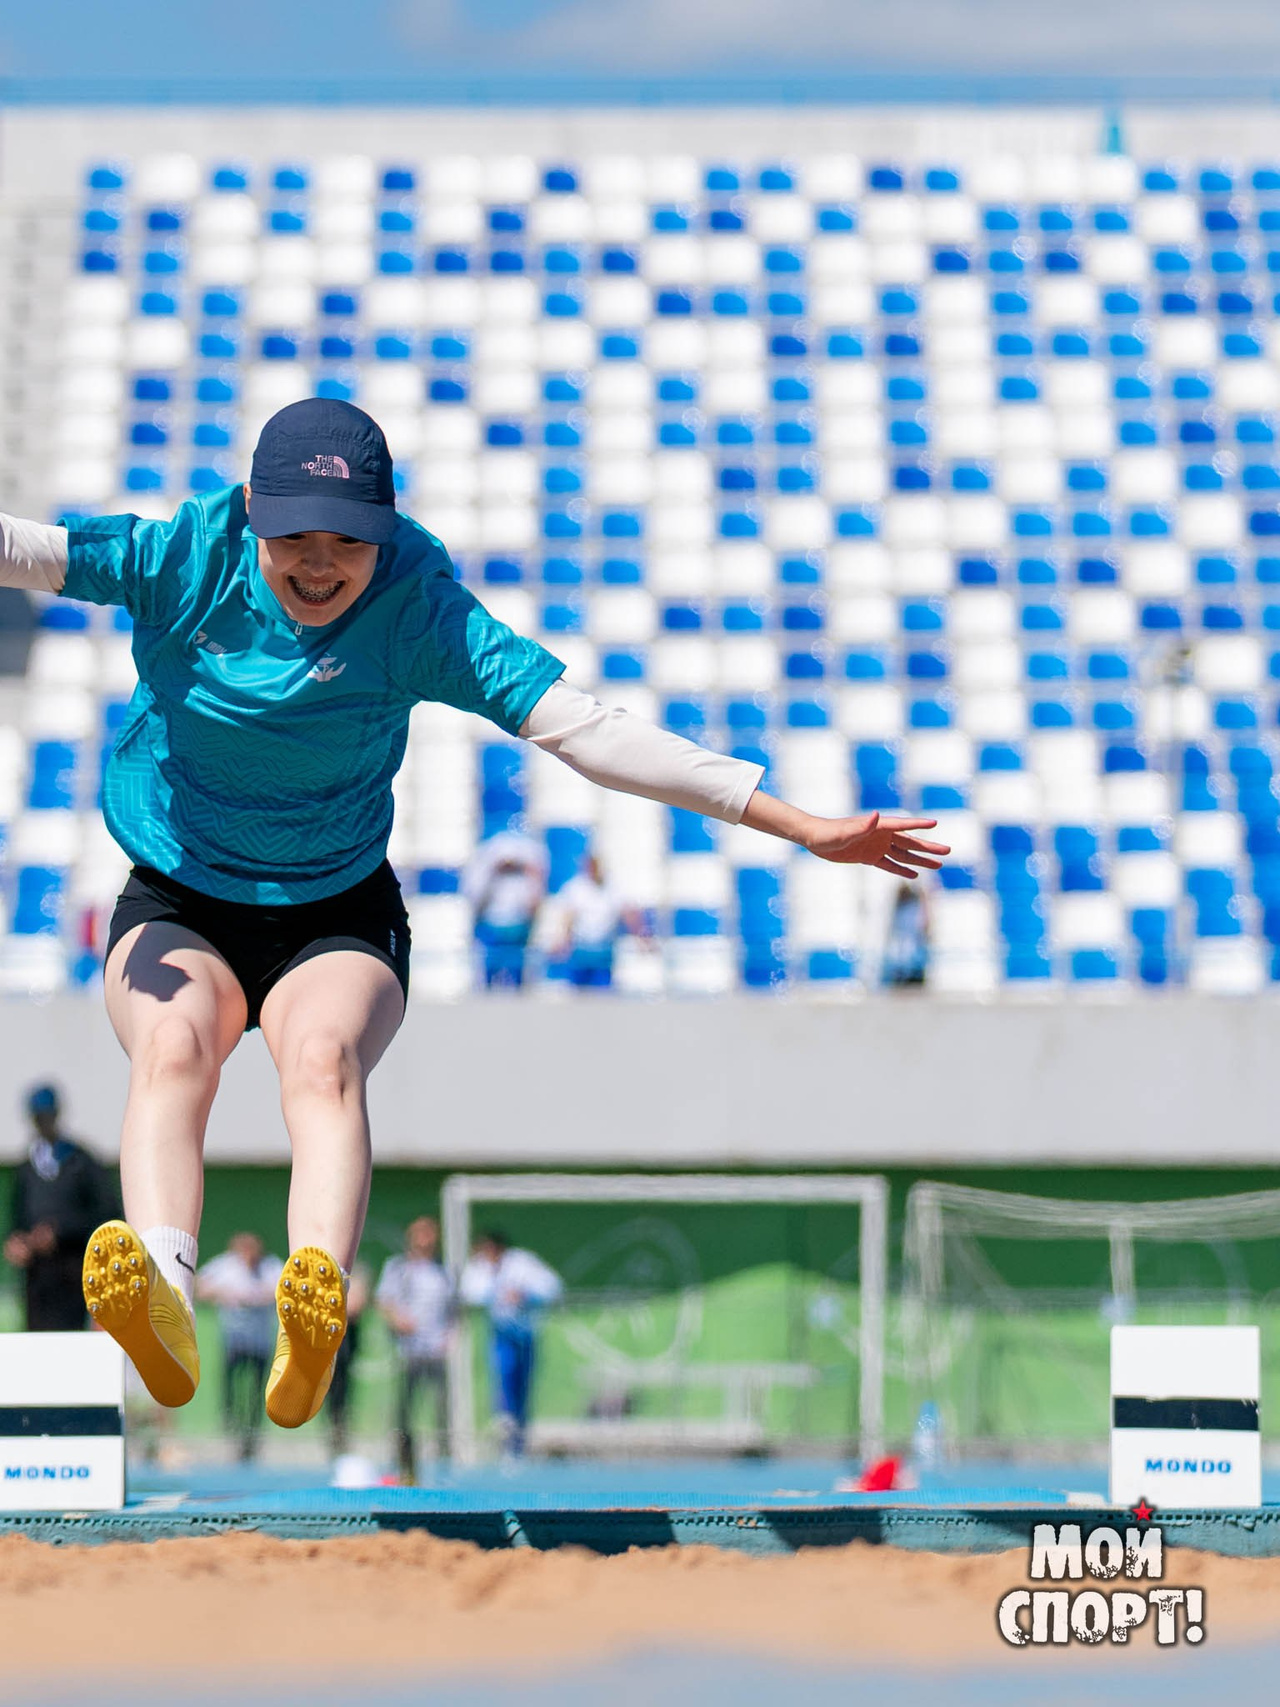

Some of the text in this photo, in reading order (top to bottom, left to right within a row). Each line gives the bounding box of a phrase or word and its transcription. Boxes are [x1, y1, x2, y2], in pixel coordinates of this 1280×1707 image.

[314, 454, 334, 463] THE
[301, 461, 333, 470] NORTH
[310, 468, 334, 477] FACE
[1145, 1458, 1231, 1474] MONDO
[5, 1466, 90, 1480] MONDO
